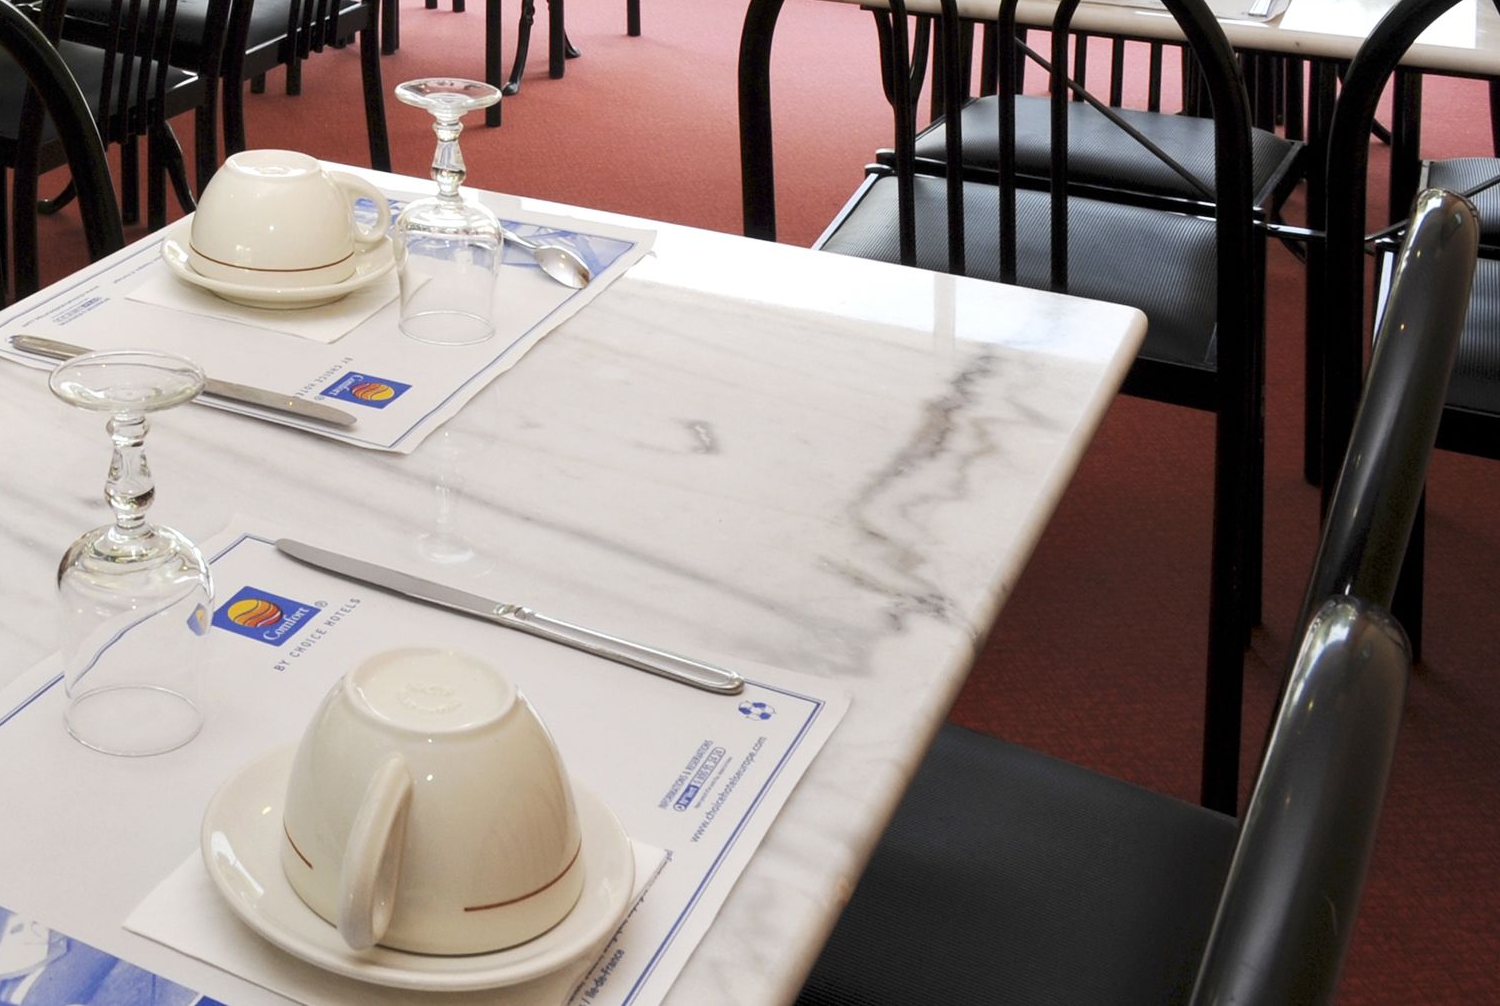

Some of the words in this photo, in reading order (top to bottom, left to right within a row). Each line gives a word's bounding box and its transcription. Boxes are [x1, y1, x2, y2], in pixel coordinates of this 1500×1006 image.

[328, 374, 365, 396] Comfort
[262, 607, 310, 641] Comfort
[273, 659, 290, 672] BY
[288, 628, 328, 658] CHOICE
[323, 597, 361, 626] HOTELS
[690, 736, 767, 842] www.choicehotelseurope.com
